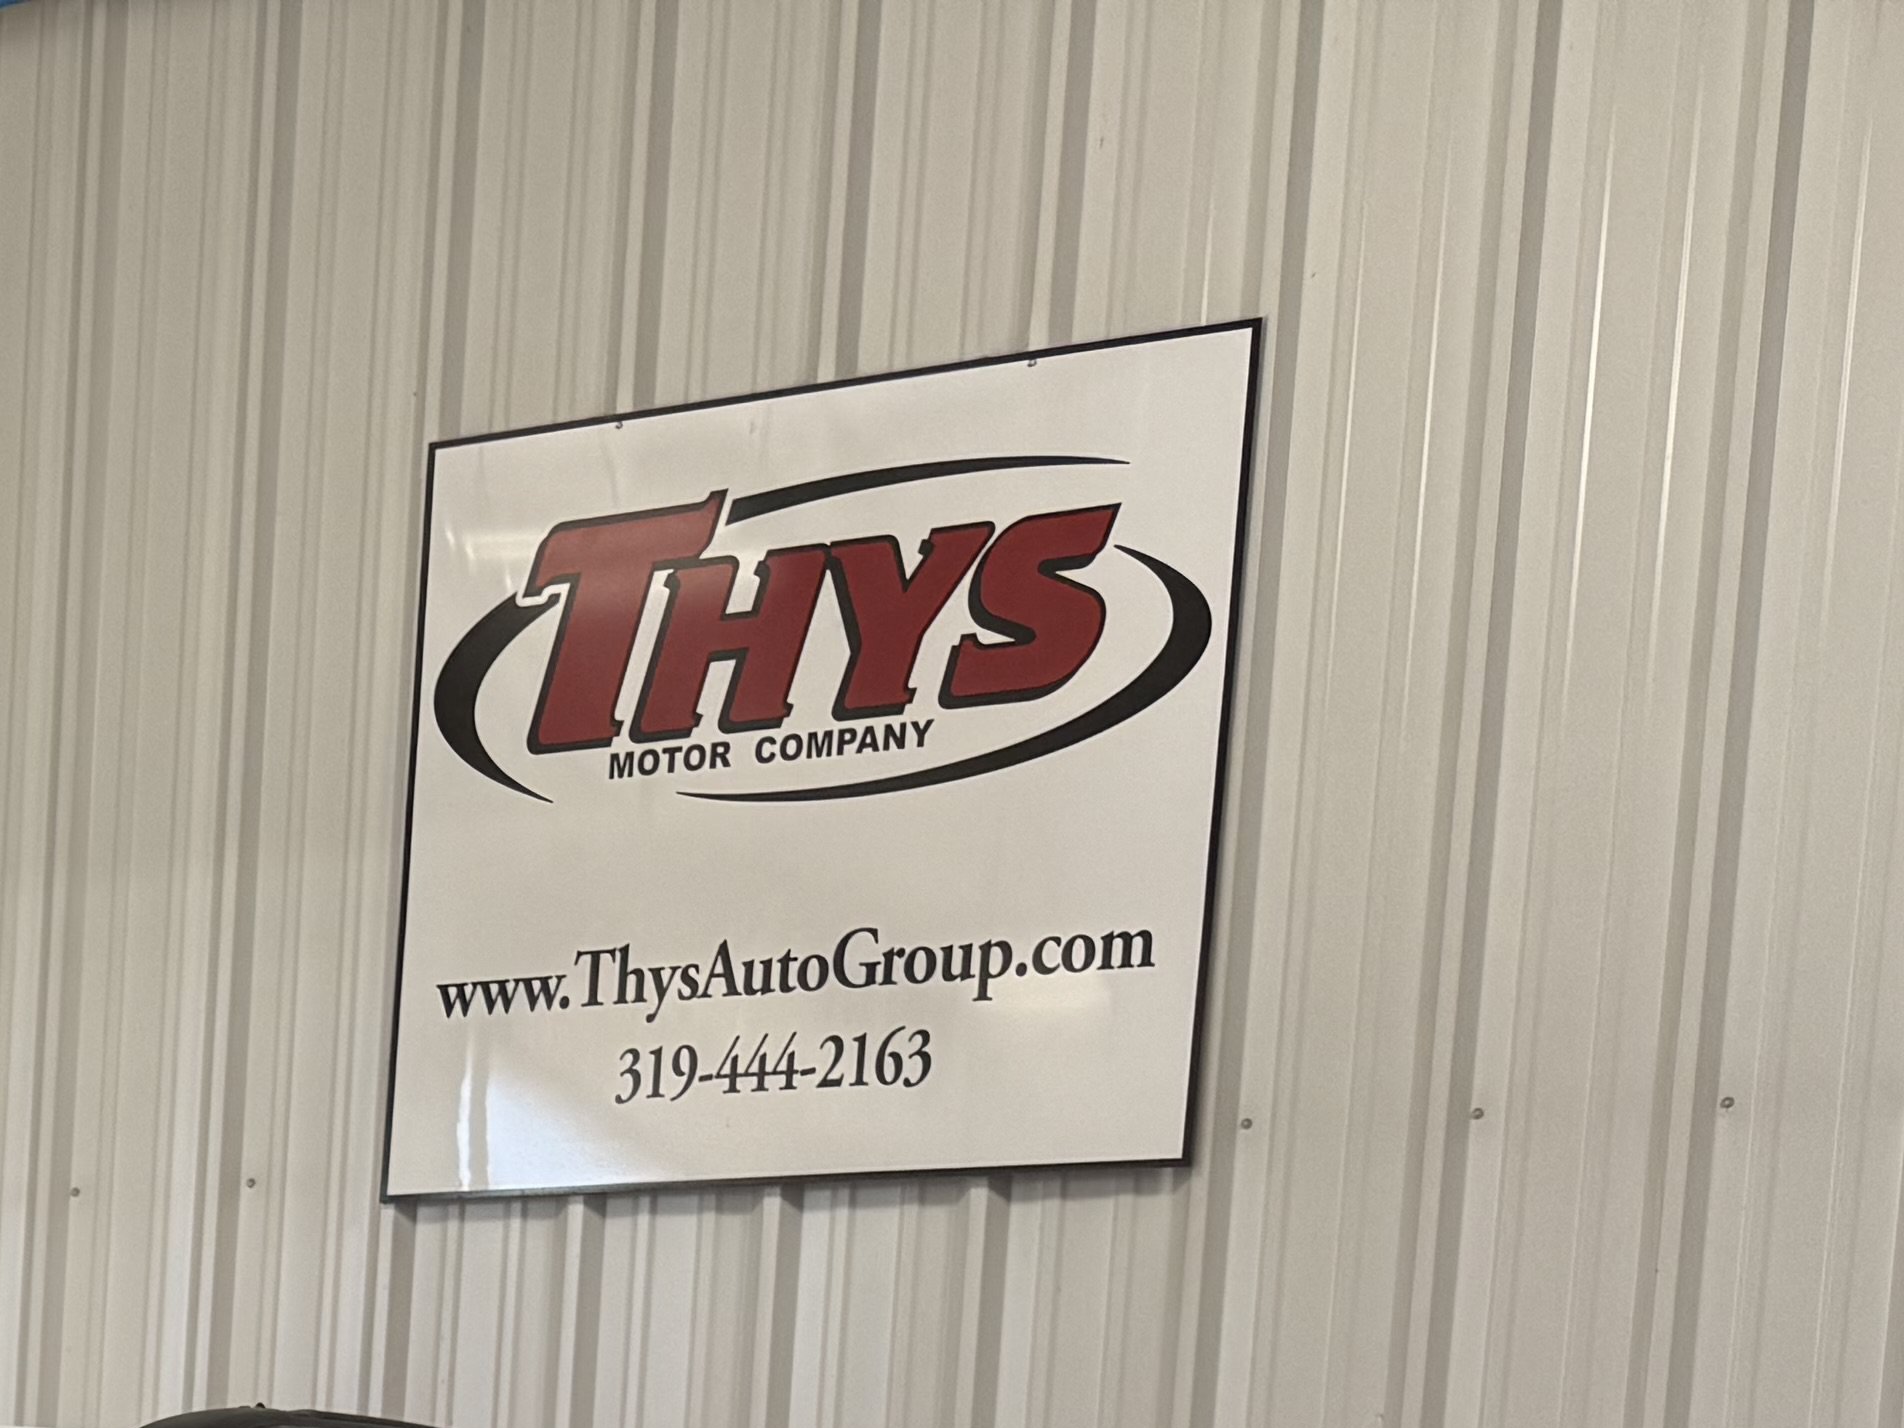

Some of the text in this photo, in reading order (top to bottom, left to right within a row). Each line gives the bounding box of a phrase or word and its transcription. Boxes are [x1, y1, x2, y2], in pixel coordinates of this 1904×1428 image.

[525, 489, 1121, 755] THYS
[608, 719, 934, 780] MOTOR COMPANY
[437, 927, 1155, 1022] www.ThysAutoGroup.com
[614, 1027, 934, 1105] 319-444-2163
